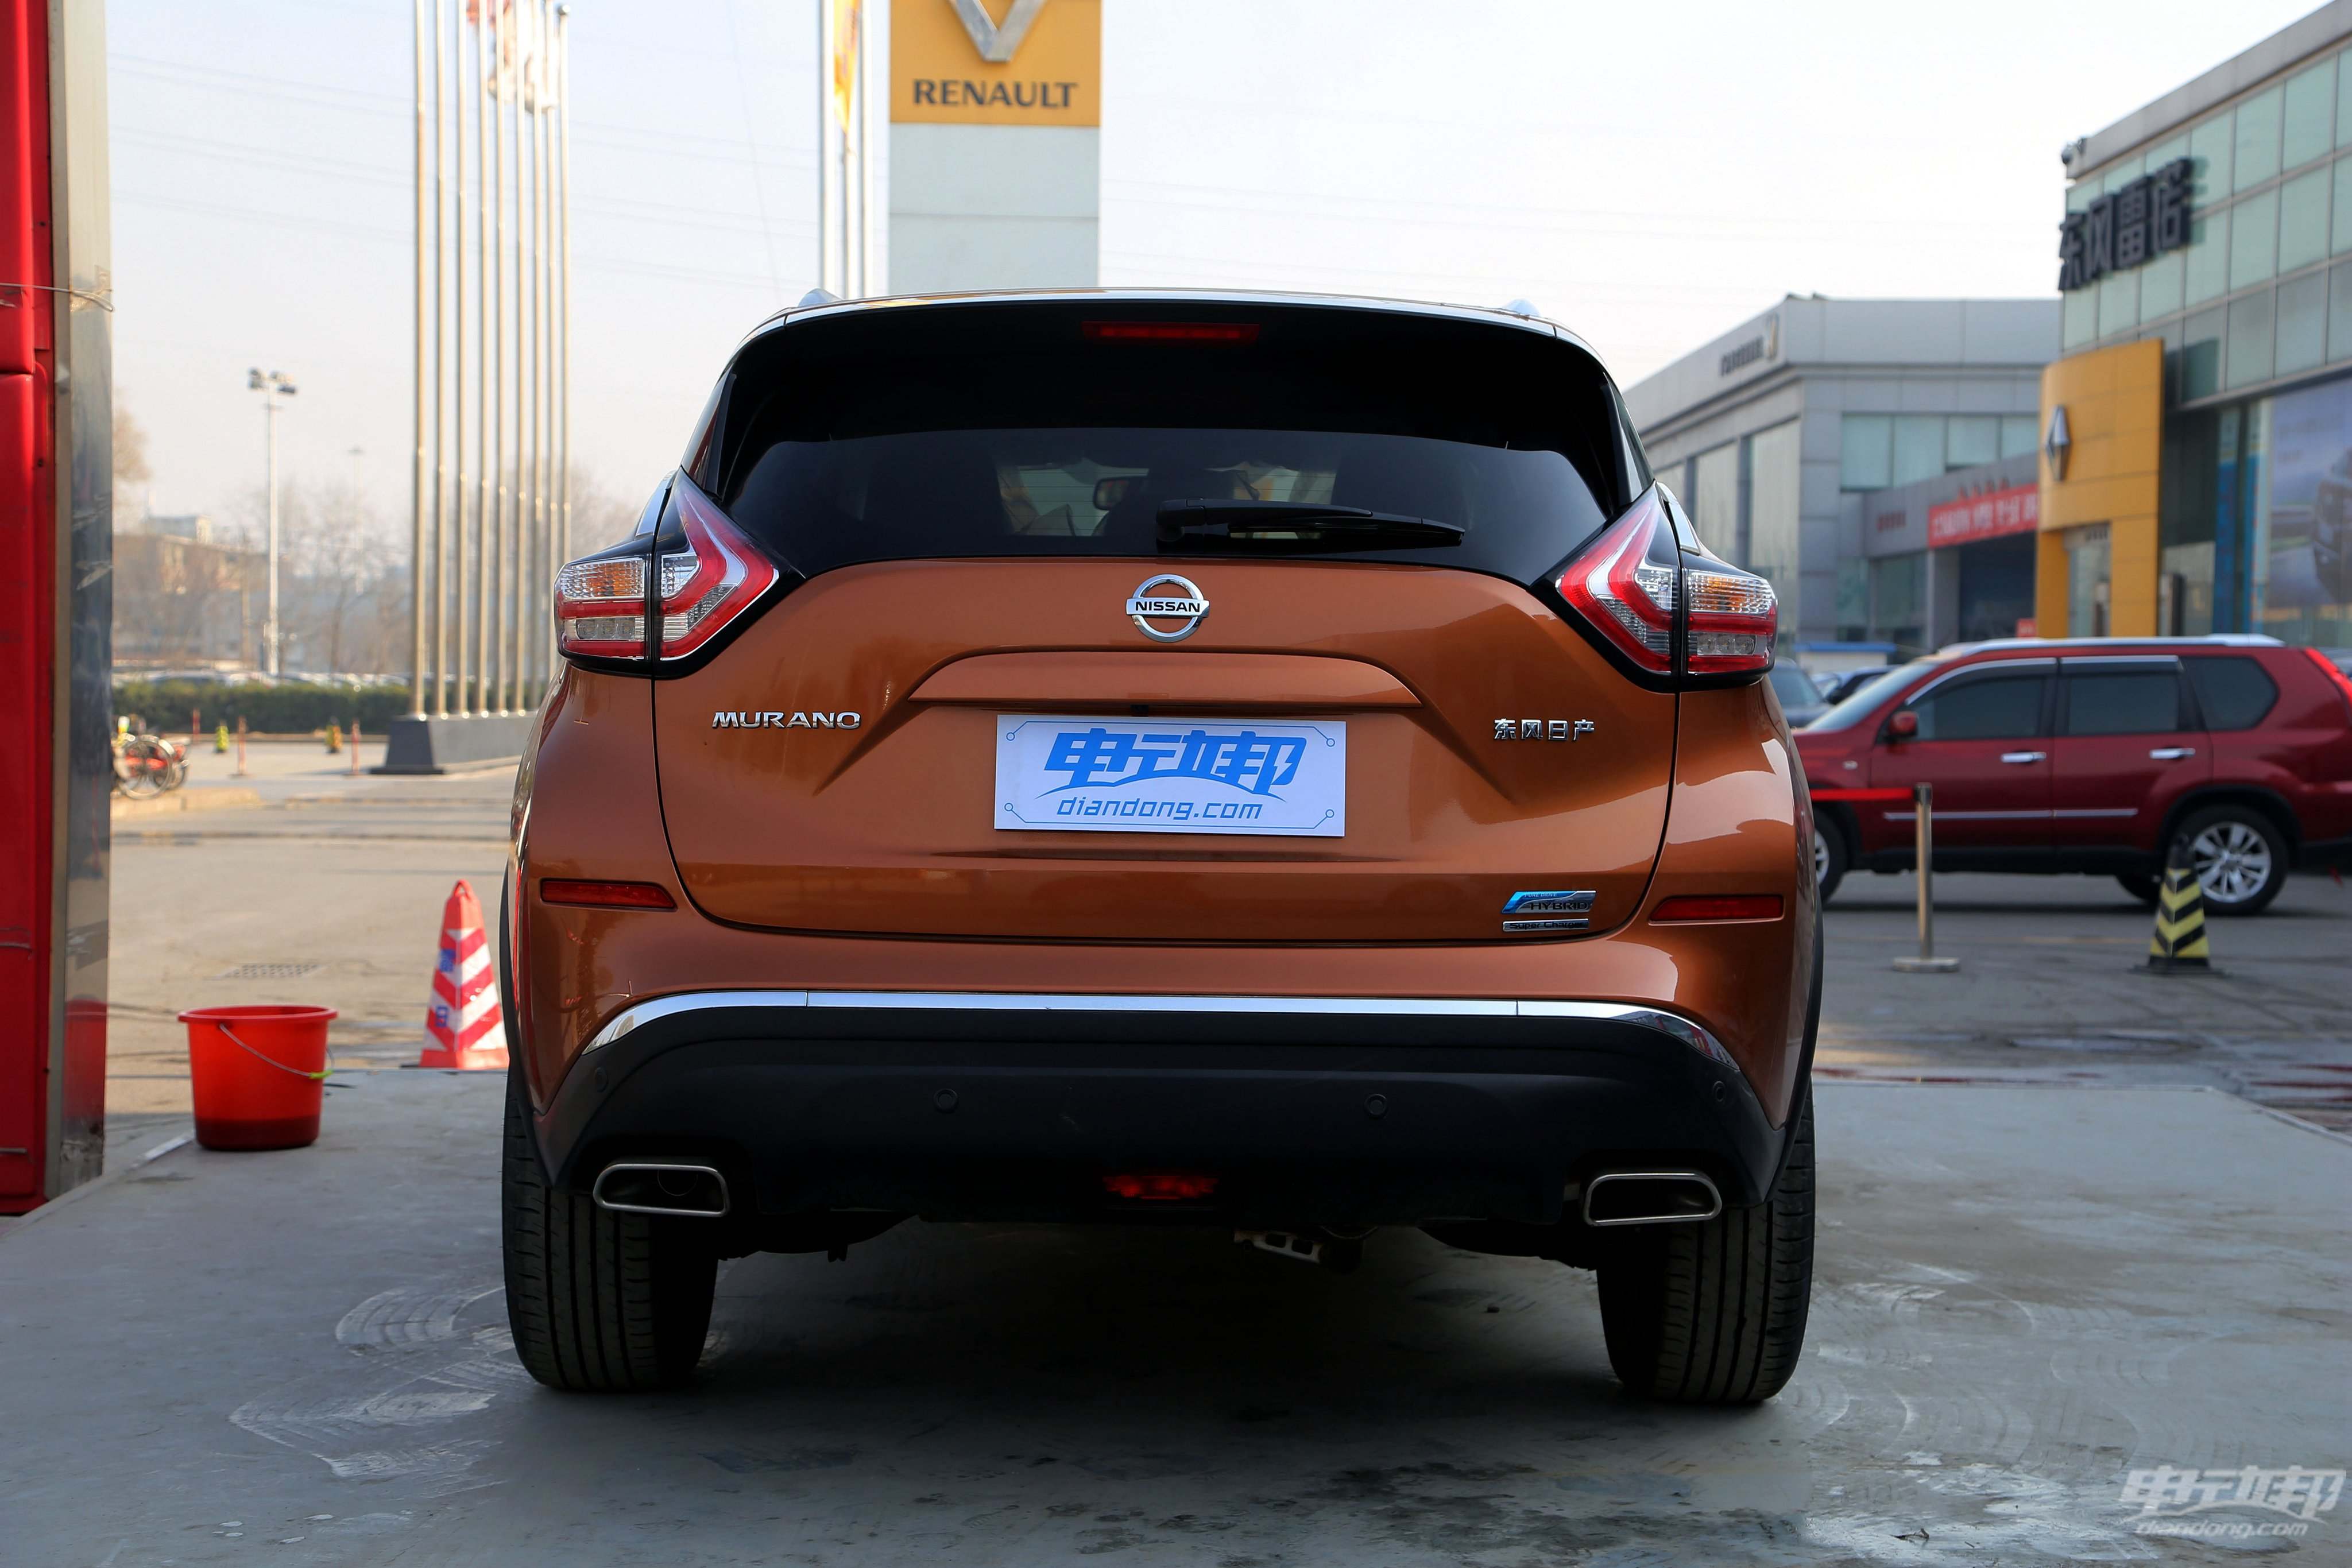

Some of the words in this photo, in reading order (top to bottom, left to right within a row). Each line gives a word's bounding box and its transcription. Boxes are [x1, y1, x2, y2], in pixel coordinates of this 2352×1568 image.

[912, 79, 1079, 109] RENAULT
[2059, 158, 2194, 291] 东风雷诺
[1135, 601, 1200, 613] NISSAN
[711, 711, 861, 730] MURANO
[1494, 718, 1595, 741] 东风日产
[1040, 727, 1307, 798] 电动邦
[1057, 797, 1263, 820] diandong.com
[1530, 902, 1588, 910] HYBRID
[1510, 922, 1541, 930] Super
